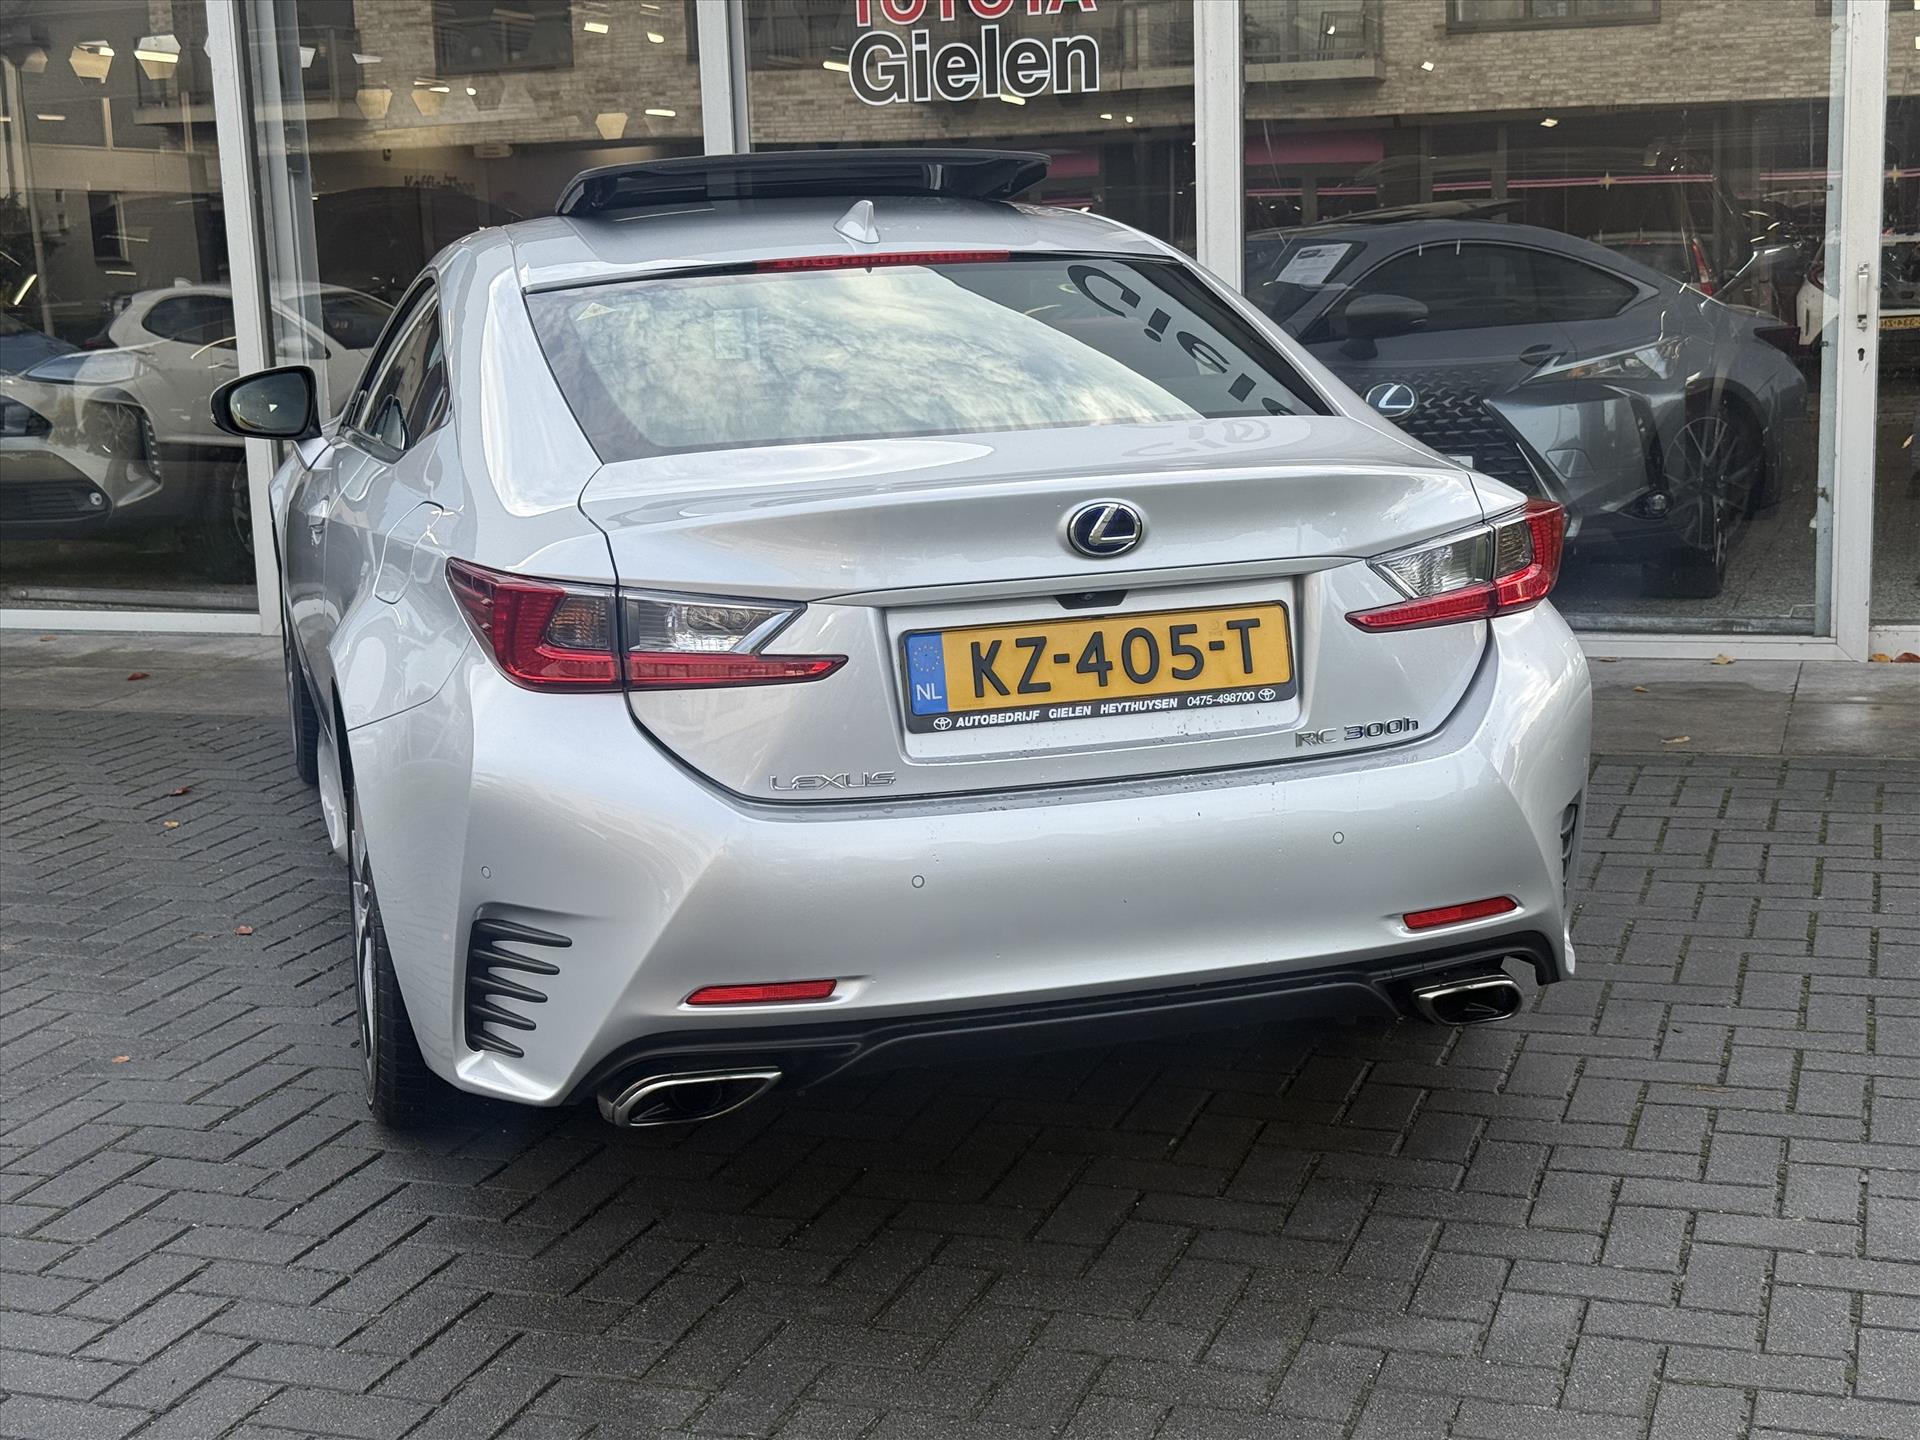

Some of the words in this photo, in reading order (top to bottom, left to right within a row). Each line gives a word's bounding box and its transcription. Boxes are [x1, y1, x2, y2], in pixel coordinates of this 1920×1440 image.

[848, 24, 1100, 105] Gielen
[971, 618, 1261, 698] KZ-405-T
[916, 683, 943, 700] NL
[956, 710, 1040, 727] AUTOBEDRIJF
[1048, 705, 1092, 719] GIELEN
[1100, 698, 1178, 715] HEYTHUYSEN
[1187, 691, 1255, 707] 0475-498700
[1295, 728, 1337, 747] RC
[1344, 717, 1419, 741] 300h
[769, 771, 897, 791] LEXUS
